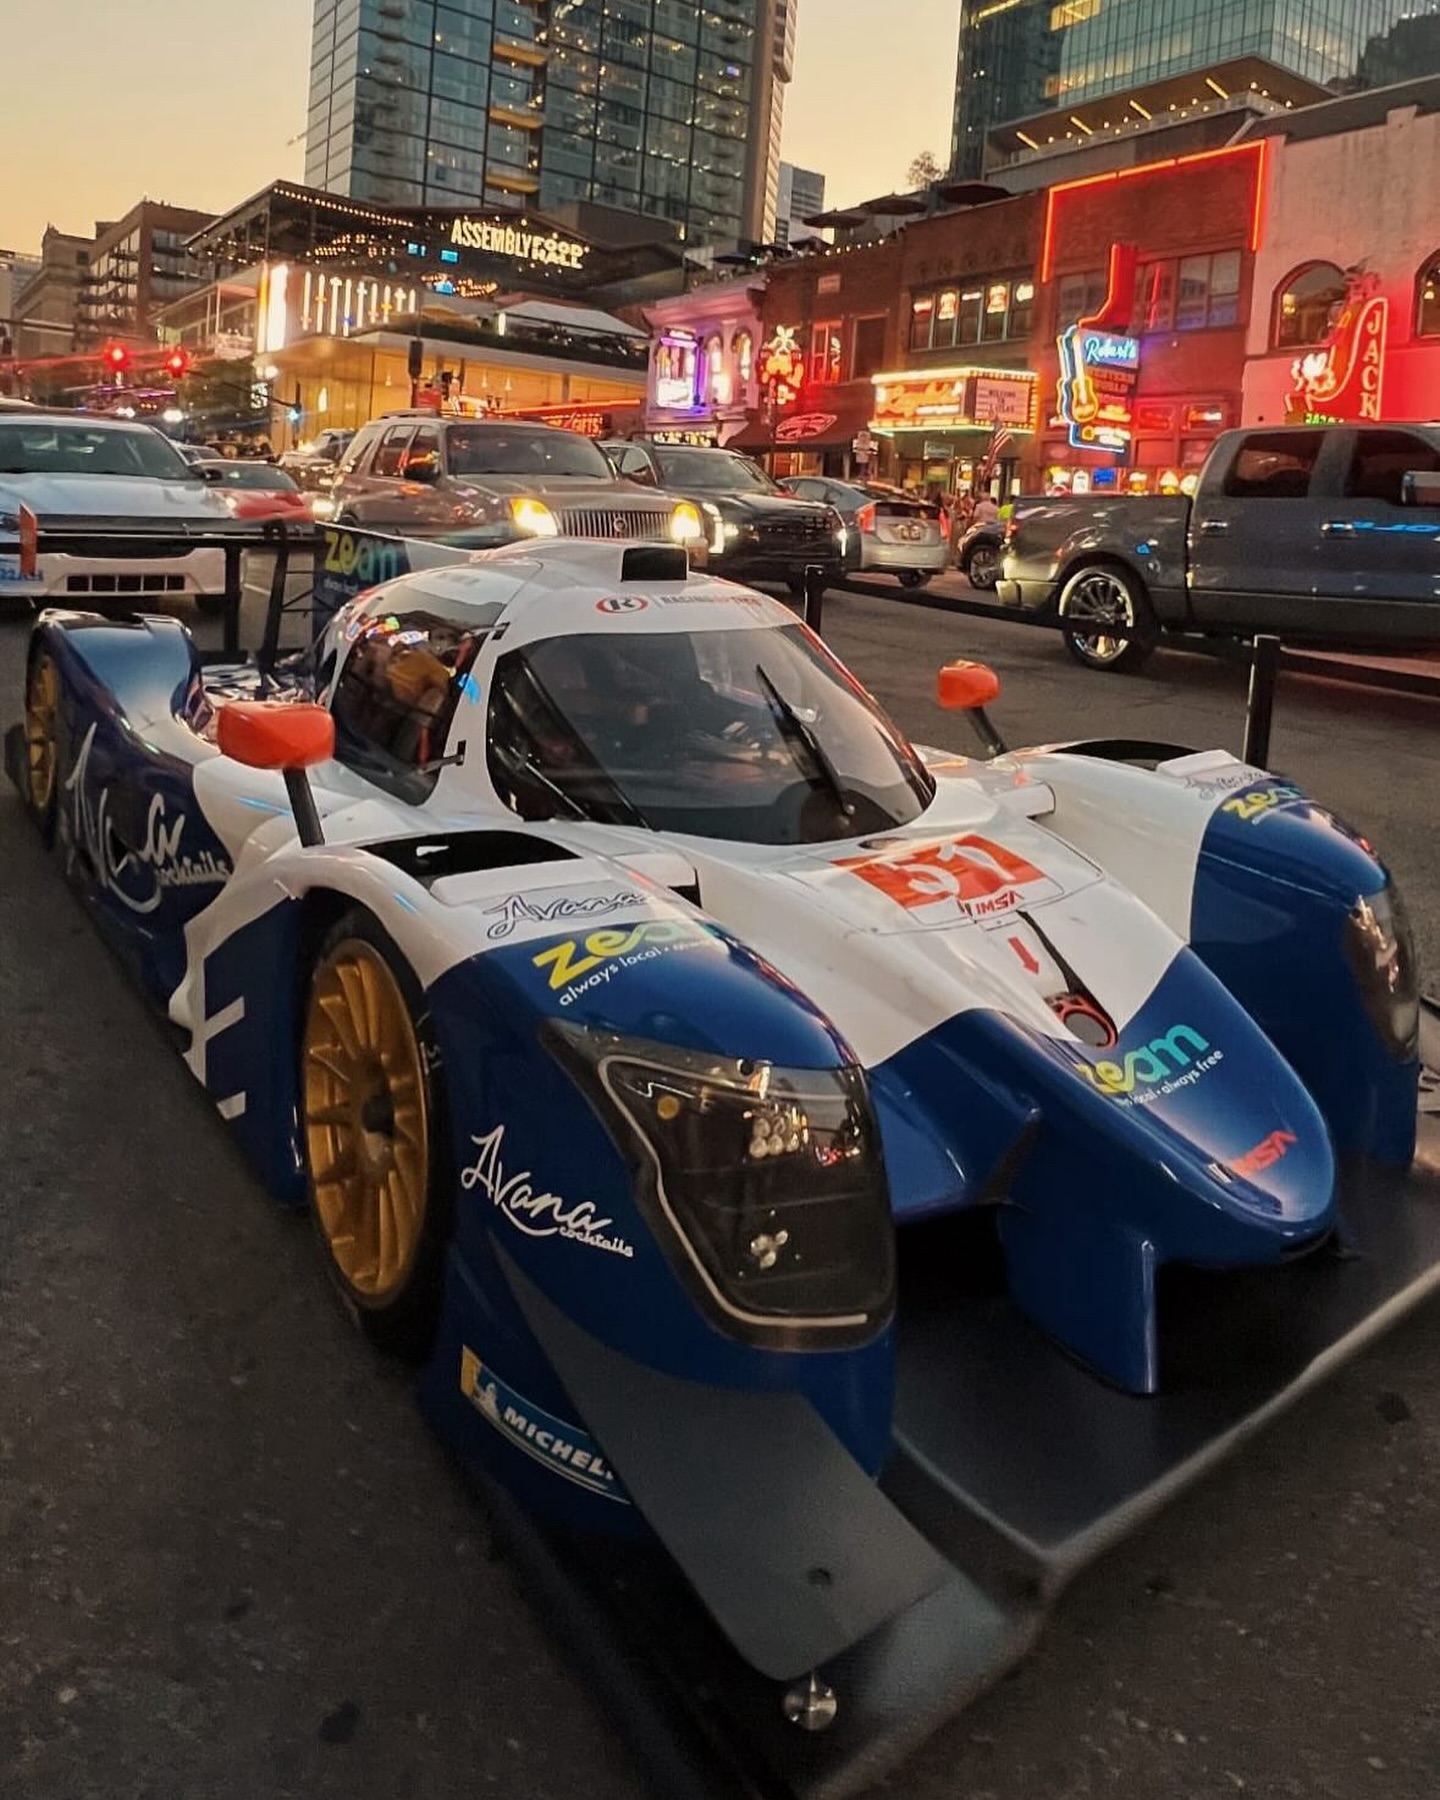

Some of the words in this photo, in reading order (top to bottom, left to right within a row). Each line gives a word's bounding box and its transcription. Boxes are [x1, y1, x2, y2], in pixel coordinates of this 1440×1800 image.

[450, 218, 532, 259] ASSEMBLY
[532, 235, 584, 258] FOOD
[1358, 309, 1381, 419] JACK
[487, 892, 650, 940] Avana
[558, 963, 620, 1007] always
[621, 945, 662, 968] local
[1161, 1068, 1201, 1095] always
[1196, 1049, 1224, 1073] free
[461, 1124, 613, 1237] Avana
[558, 1226, 634, 1258] cocktails
